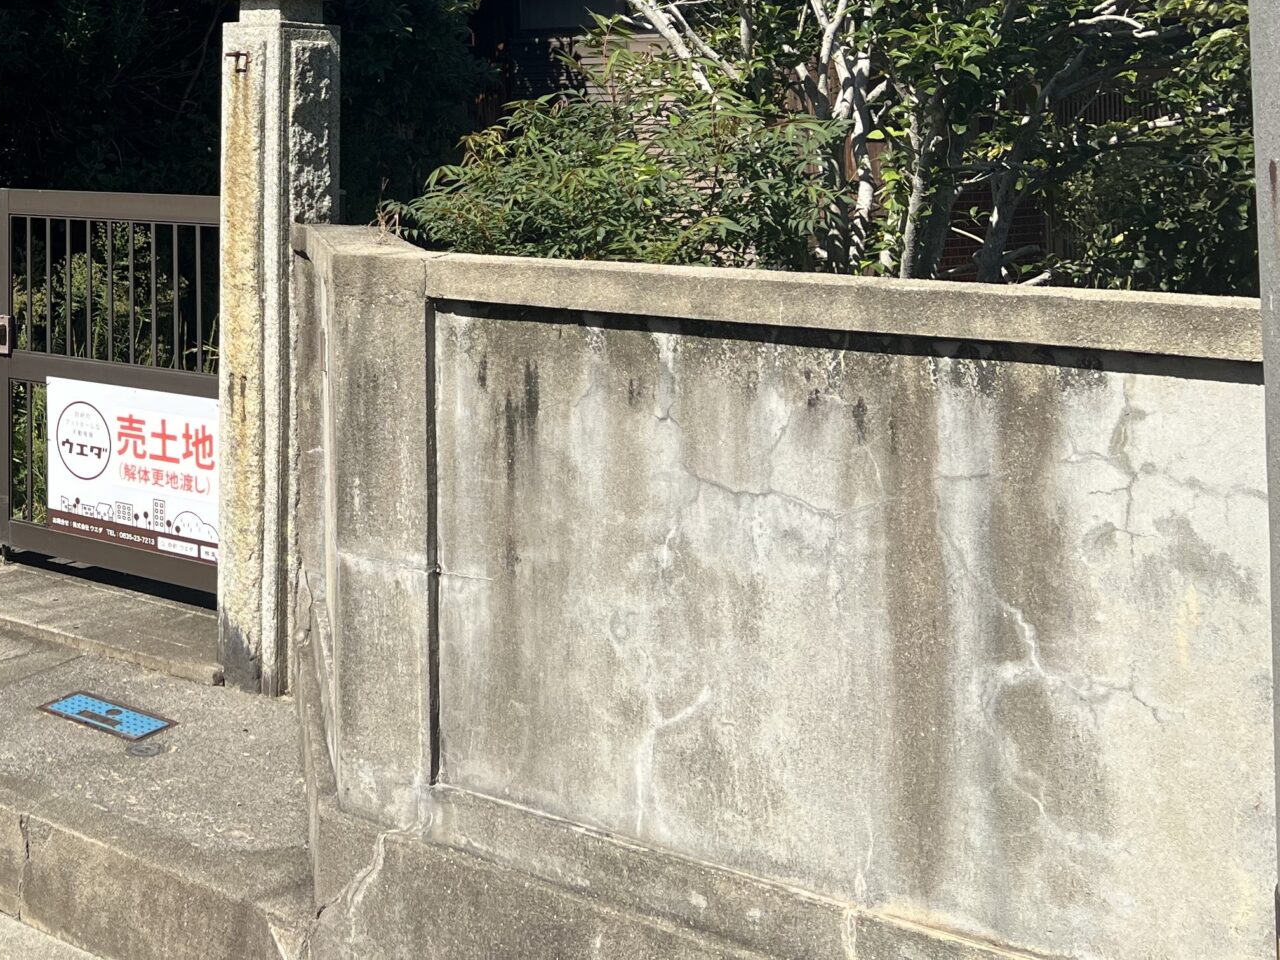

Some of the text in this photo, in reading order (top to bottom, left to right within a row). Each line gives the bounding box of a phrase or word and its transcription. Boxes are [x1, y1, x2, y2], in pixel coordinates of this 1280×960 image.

[61, 438, 107, 459] ウエダ
[117, 414, 215, 470] 売土地
